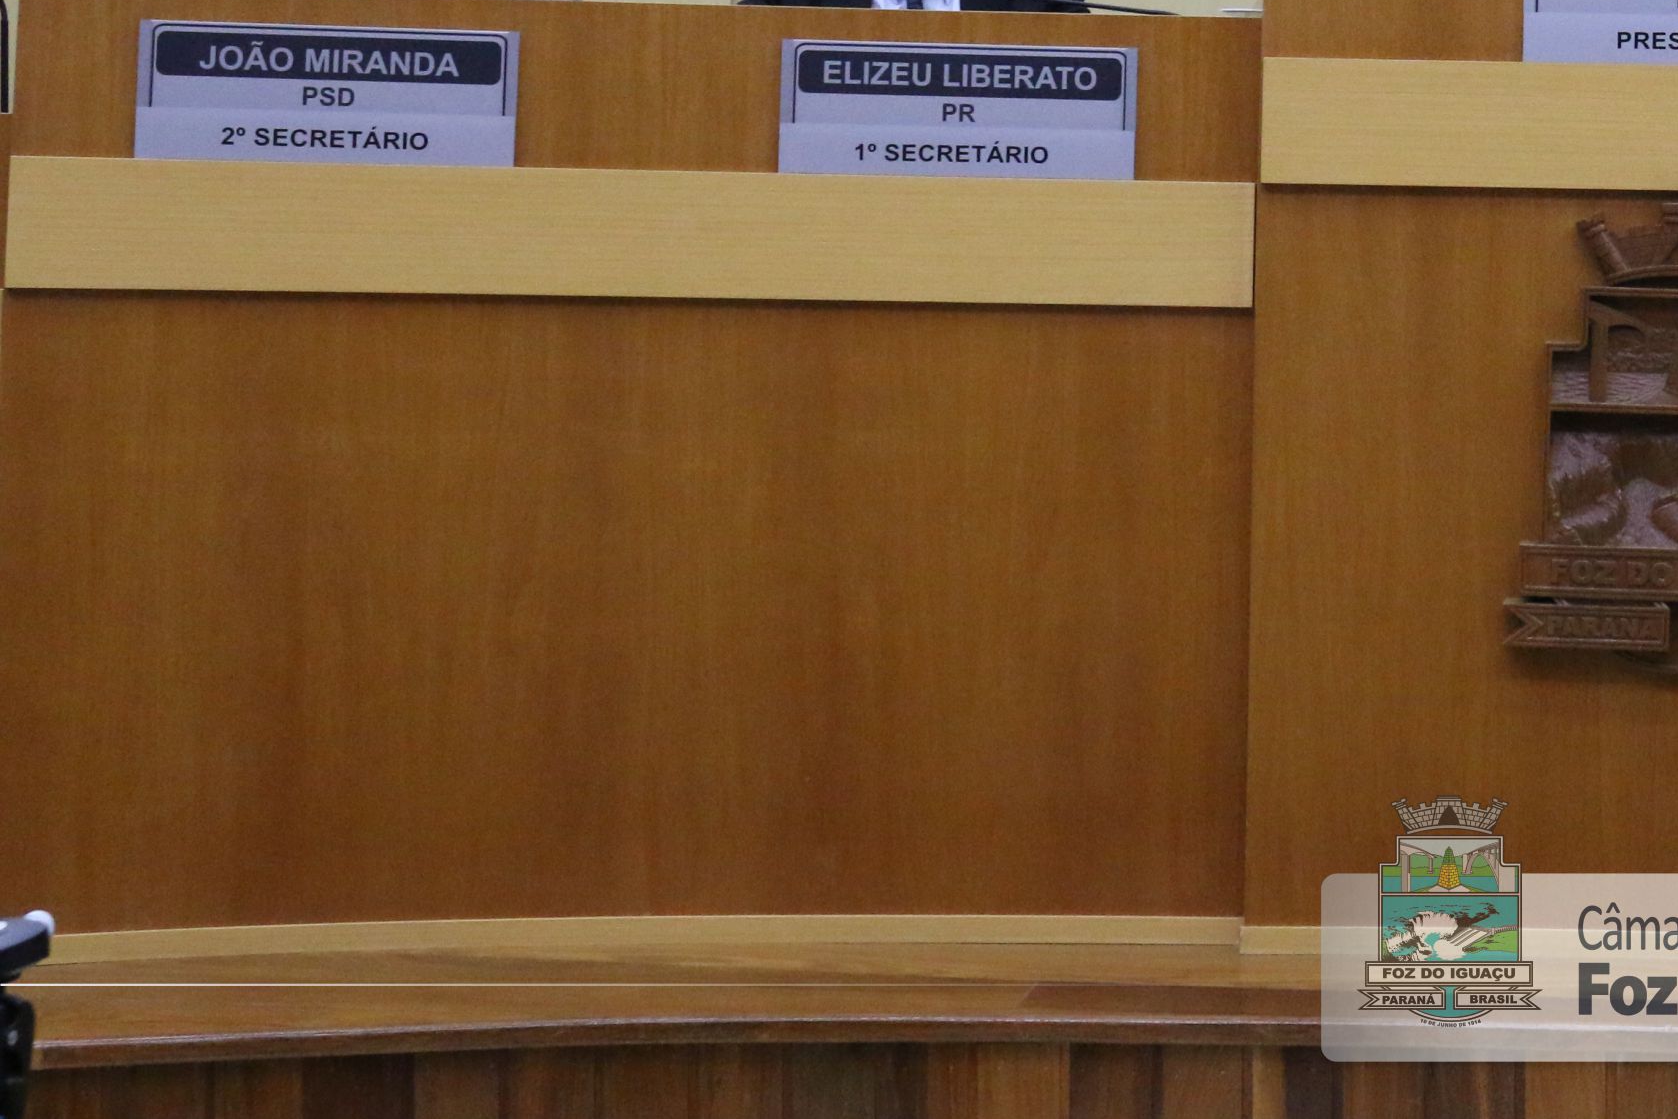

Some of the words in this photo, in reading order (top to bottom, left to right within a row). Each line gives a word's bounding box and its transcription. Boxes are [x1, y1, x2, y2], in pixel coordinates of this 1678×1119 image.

[199, 41, 294, 72] JOÃO
[304, 48, 460, 78] MIRANDA
[822, 60, 932, 87] ELIZEU
[942, 63, 1098, 91] LIBERATO
[302, 86, 355, 108] PSD
[941, 103, 976, 123] PR
[220, 126, 246, 147] 2º
[254, 126, 429, 151] SECRETÁRIO
[854, 143, 877, 162] 1º
[884, 140, 1049, 164] SECRETÁRIO
[1551, 558, 1616, 582] FOZ
[1627, 561, 1672, 583] DO
